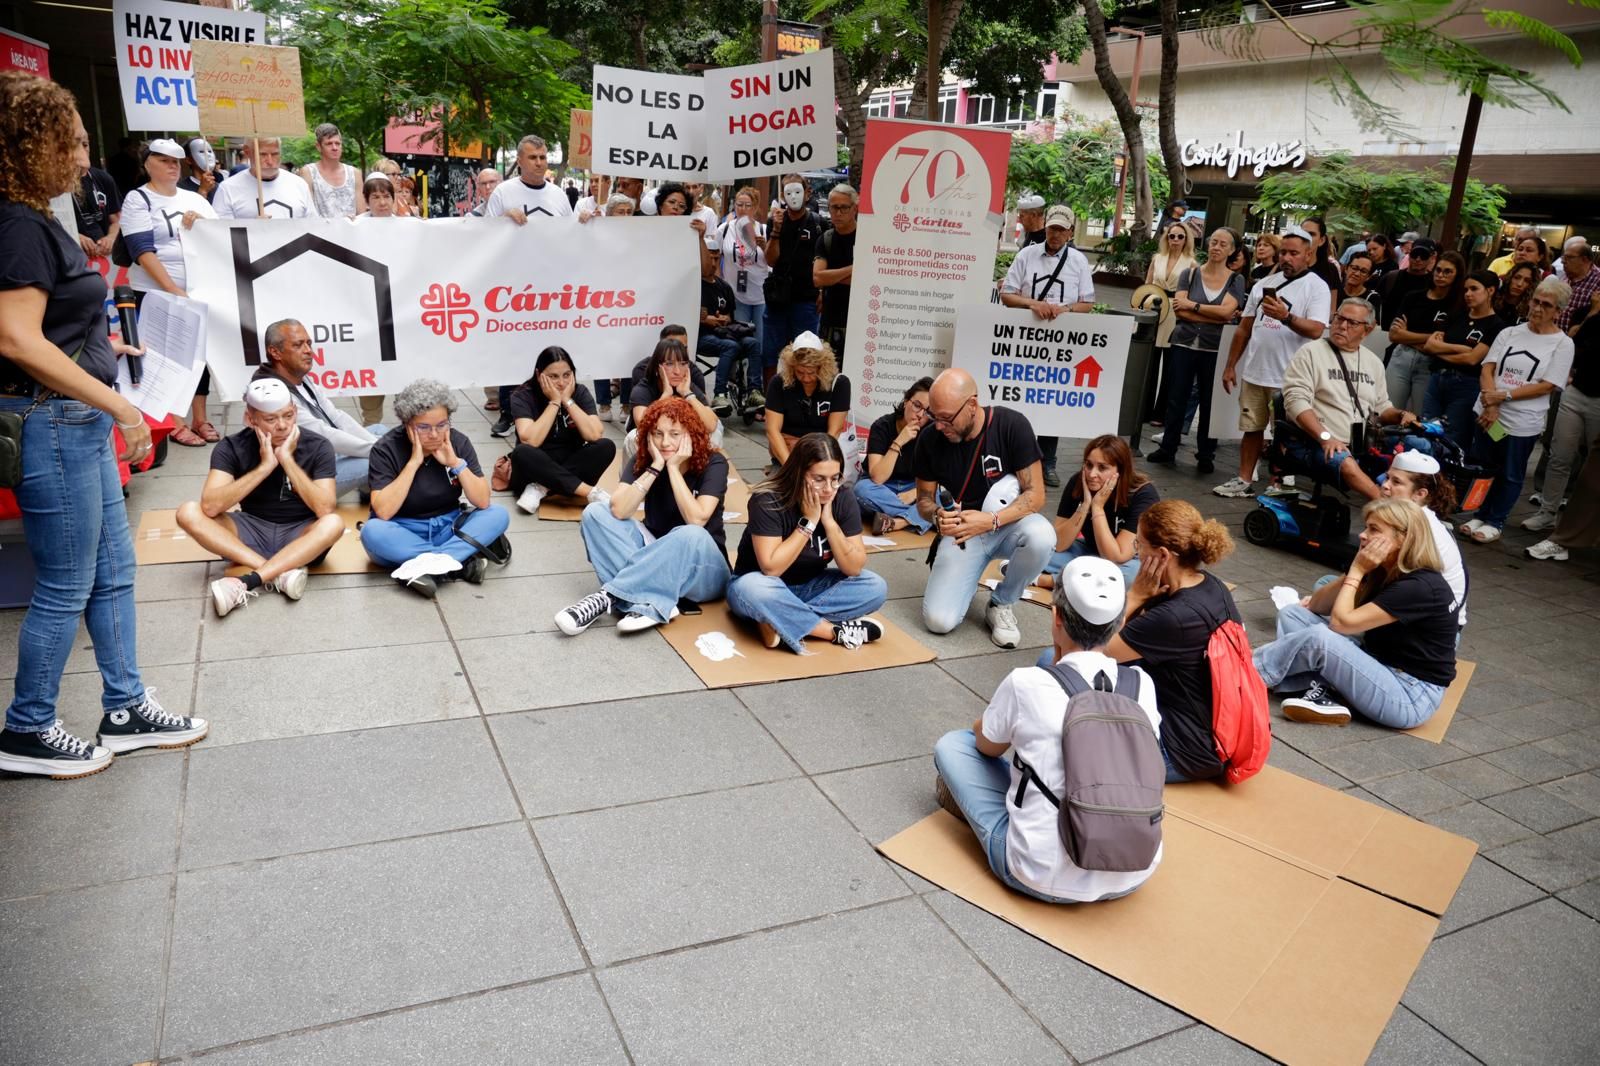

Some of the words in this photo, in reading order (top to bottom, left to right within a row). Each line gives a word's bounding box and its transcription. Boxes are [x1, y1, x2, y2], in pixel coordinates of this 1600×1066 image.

[125, 12, 173, 42] HAZ
[178, 19, 256, 44] VISIBLE
[127, 44, 153, 69] LO
[159, 47, 193, 71] INV
[730, 74, 771, 99] SIN
[778, 66, 812, 92] UN
[596, 82, 633, 104] NO
[640, 89, 681, 111] LES
[687, 94, 705, 112] D
[728, 104, 816, 135] HOGAR
[647, 121, 678, 141] LA
[733, 142, 813, 169] DIGNO
[894, 147, 966, 205] 70
[913, 216, 964, 229] Cáritas
[872, 245, 892, 255] Más
[893, 247, 905, 256] de
[907, 248, 932, 258] 8.500
[933, 251, 977, 262] personas
[877, 256, 950, 270] comprometidas
[951, 262, 969, 271] con
[878, 267, 919, 277] nuestros
[920, 271, 967, 281] proyectos
[484, 284, 636, 313] Cáritas
[883, 286, 919, 297] Personas
[920, 290, 931, 298] sin
[932, 290, 955, 301] hogar
[882, 300, 917, 311] Personas
[918, 303, 956, 314] migrantes
[486, 317, 568, 333] Diocesana
[573, 315, 591, 329] de
[596, 313, 665, 328] Canarias
[880, 316, 910, 326] Empleo
[910, 319, 915, 327] y
[916, 319, 954, 329] formación
[313, 323, 355, 343] DIE
[880, 330, 900, 340] Mujer
[908, 332, 933, 341] familia
[994, 324, 1014, 339] UN
[1019, 326, 1064, 343] TECHO
[1067, 331, 1088, 346] NO
[1091, 333, 1108, 348] ES
[878, 344, 908, 352] Infancia
[914, 347, 947, 355] mayores
[991, 342, 1011, 357] UN
[1015, 344, 1052, 363] LUJO,
[1056, 349, 1073, 363] ES
[877, 357, 921, 367] Prostitución
[922, 360, 927, 368] y
[928, 361, 946, 369] trata
[989, 361, 1071, 385] DERECHO
[875, 371, 917, 382] Adicciones
[988, 384, 998, 401] Y
[1002, 386, 1021, 402] ES
[1025, 387, 1095, 409] REFUGIO
